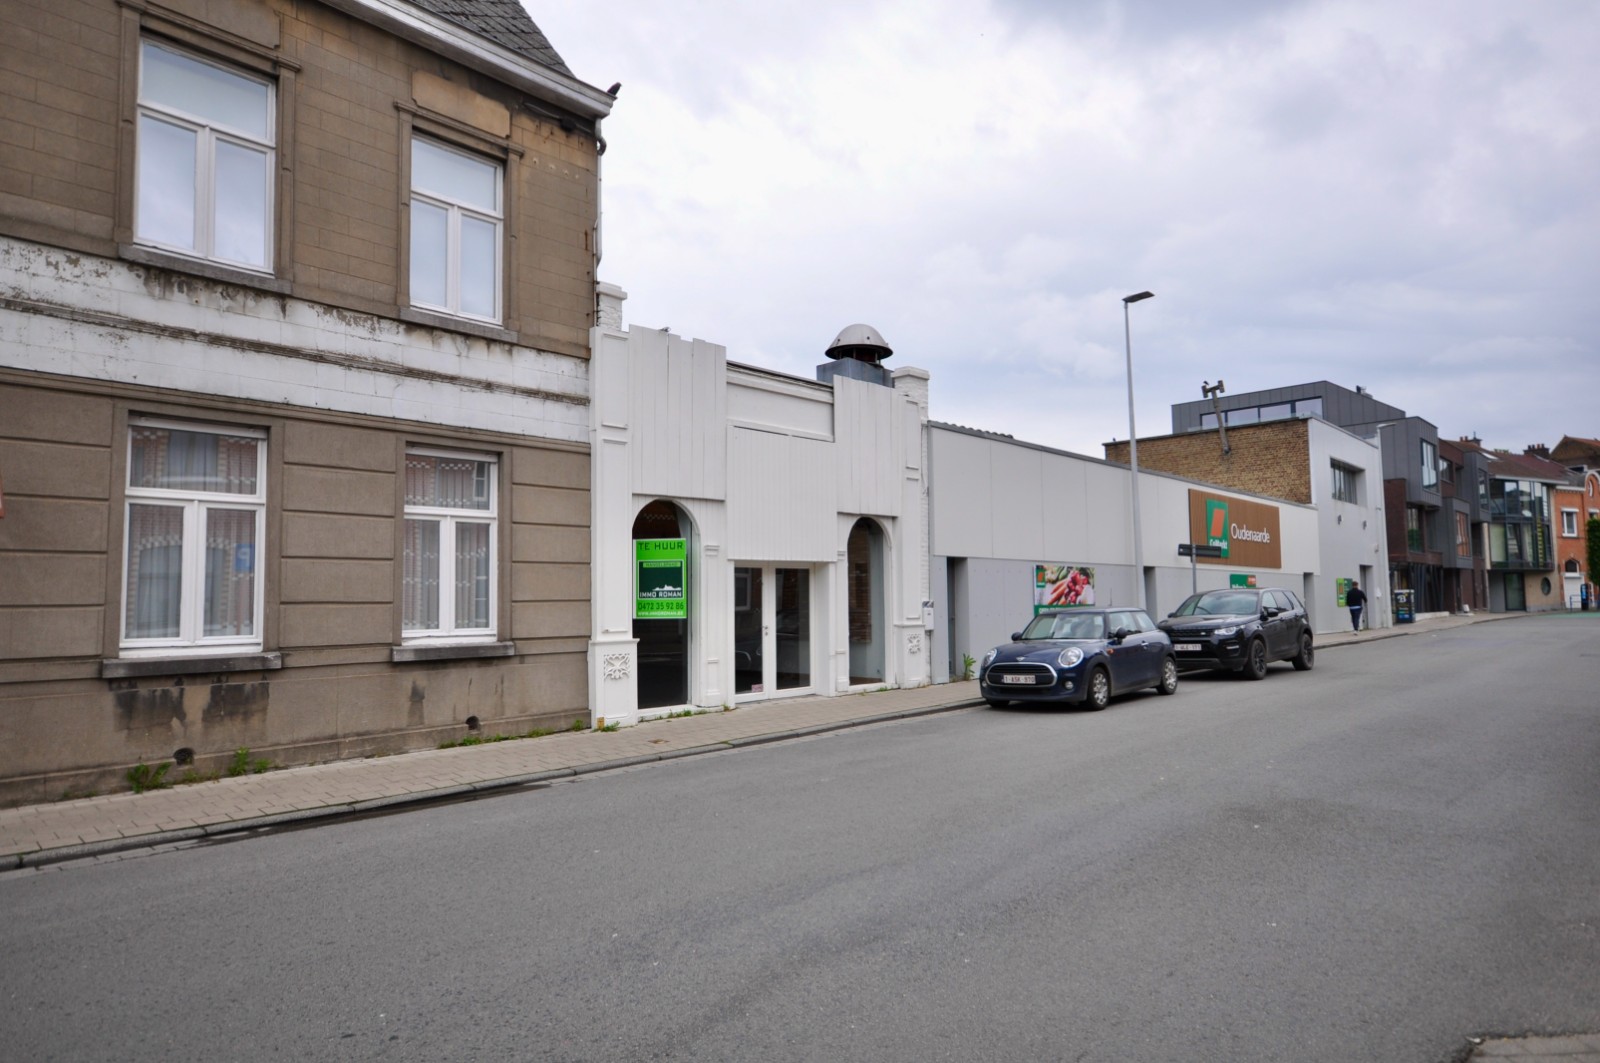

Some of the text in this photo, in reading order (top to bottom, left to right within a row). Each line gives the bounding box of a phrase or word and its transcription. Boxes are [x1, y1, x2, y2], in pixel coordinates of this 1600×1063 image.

[1230, 523, 1270, 544] Oudenaarde
[638, 541, 683, 551] TE HUUR
[638, 602, 684, 610] 0472 35 92 86
